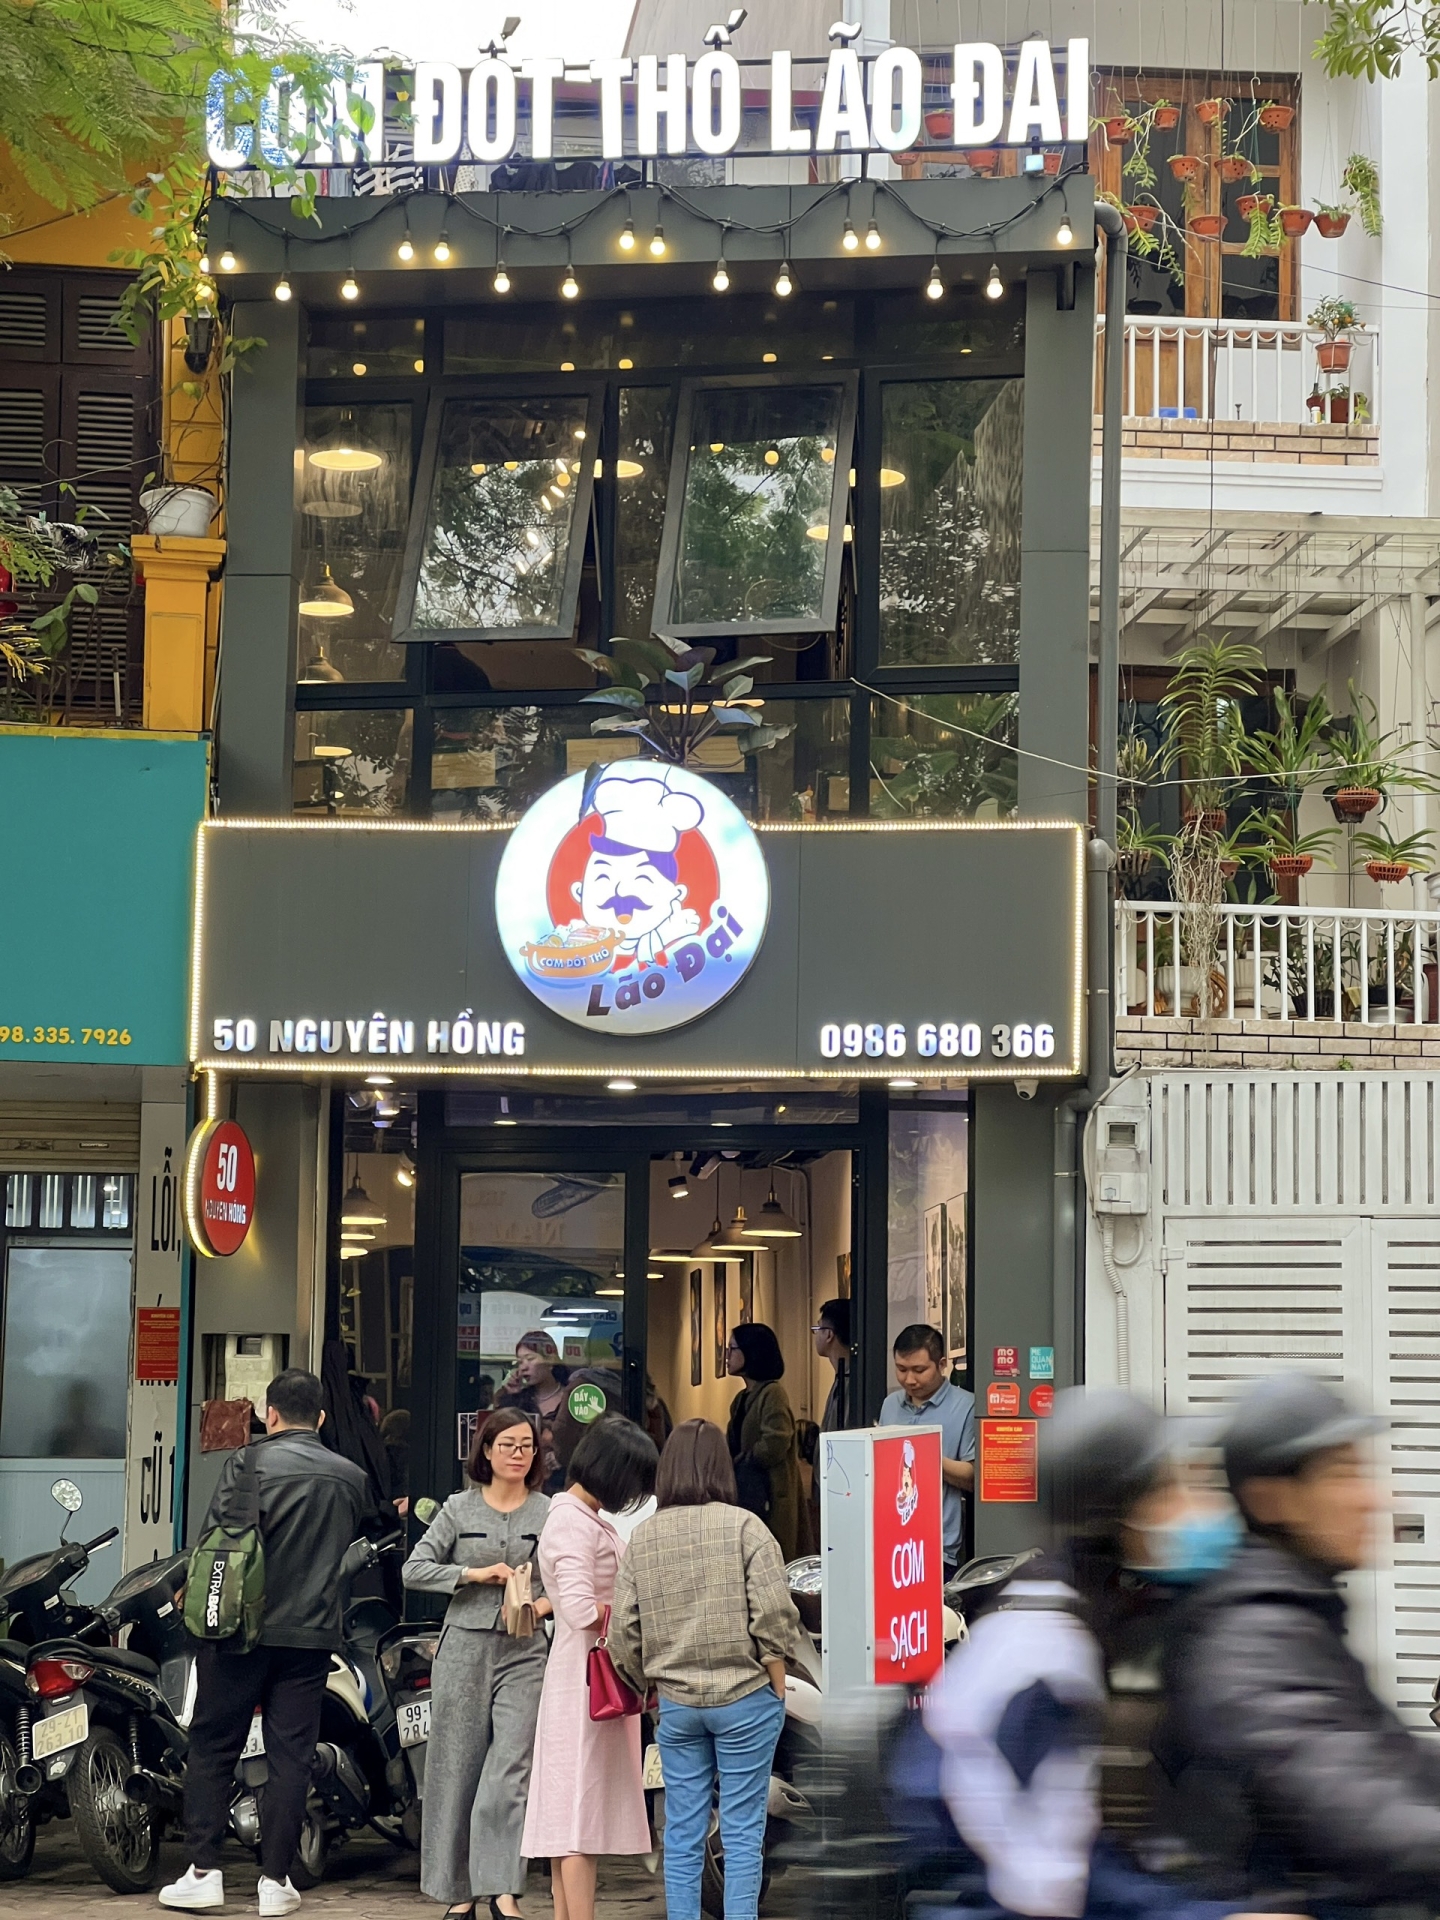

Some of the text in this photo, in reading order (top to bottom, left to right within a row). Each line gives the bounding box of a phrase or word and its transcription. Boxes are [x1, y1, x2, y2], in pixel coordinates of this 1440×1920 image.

[411, 17, 564, 162] ĐỐT
[590, 9, 748, 158] THỐ
[770, 21, 922, 151] LÃO
[586, 906, 743, 1016] Lão Đại
[212, 1018, 257, 1052] 50
[268, 1012, 414, 1055] NGUYÊN
[820, 1023, 1054, 1058] 0986 680 366
[216, 1142, 238, 1192] 50
[891, 1537, 925, 1590] CƠM
[890, 1608, 928, 1670] SẠCH
[37, 1724, 84, 1756] 263.10
[41, 1710, 78, 1738] 29-Z1
